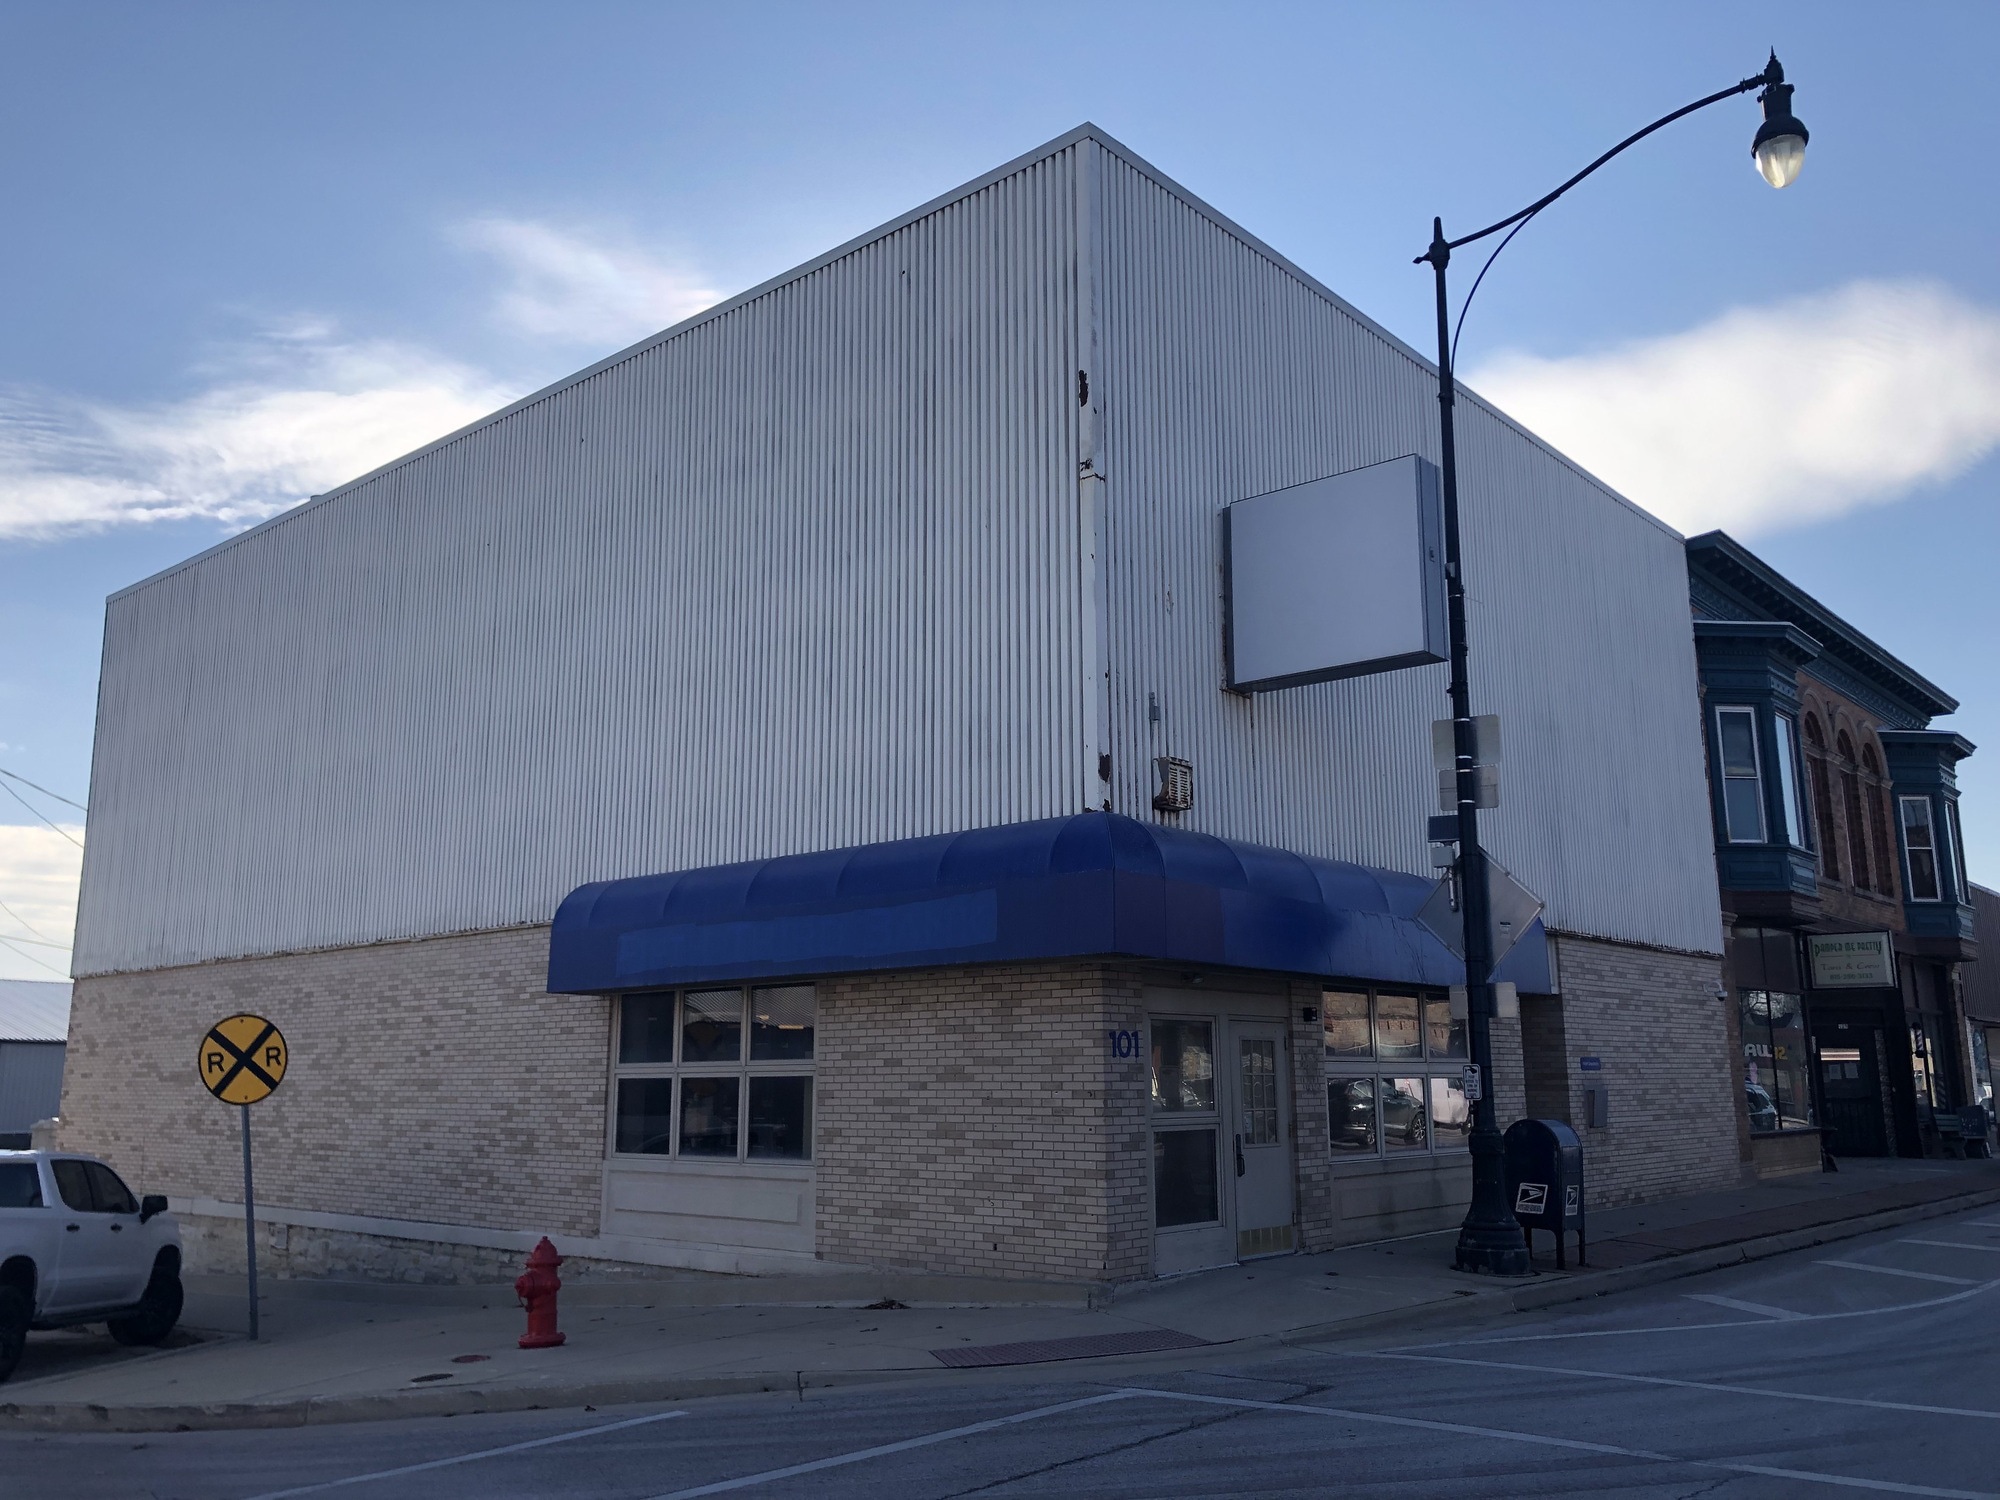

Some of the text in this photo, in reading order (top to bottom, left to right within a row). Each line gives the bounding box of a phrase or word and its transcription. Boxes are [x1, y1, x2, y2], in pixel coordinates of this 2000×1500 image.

[1845, 962, 1853, 970] &
[1109, 1030, 1139, 1058] 101
[207, 1046, 281, 1074] R R
